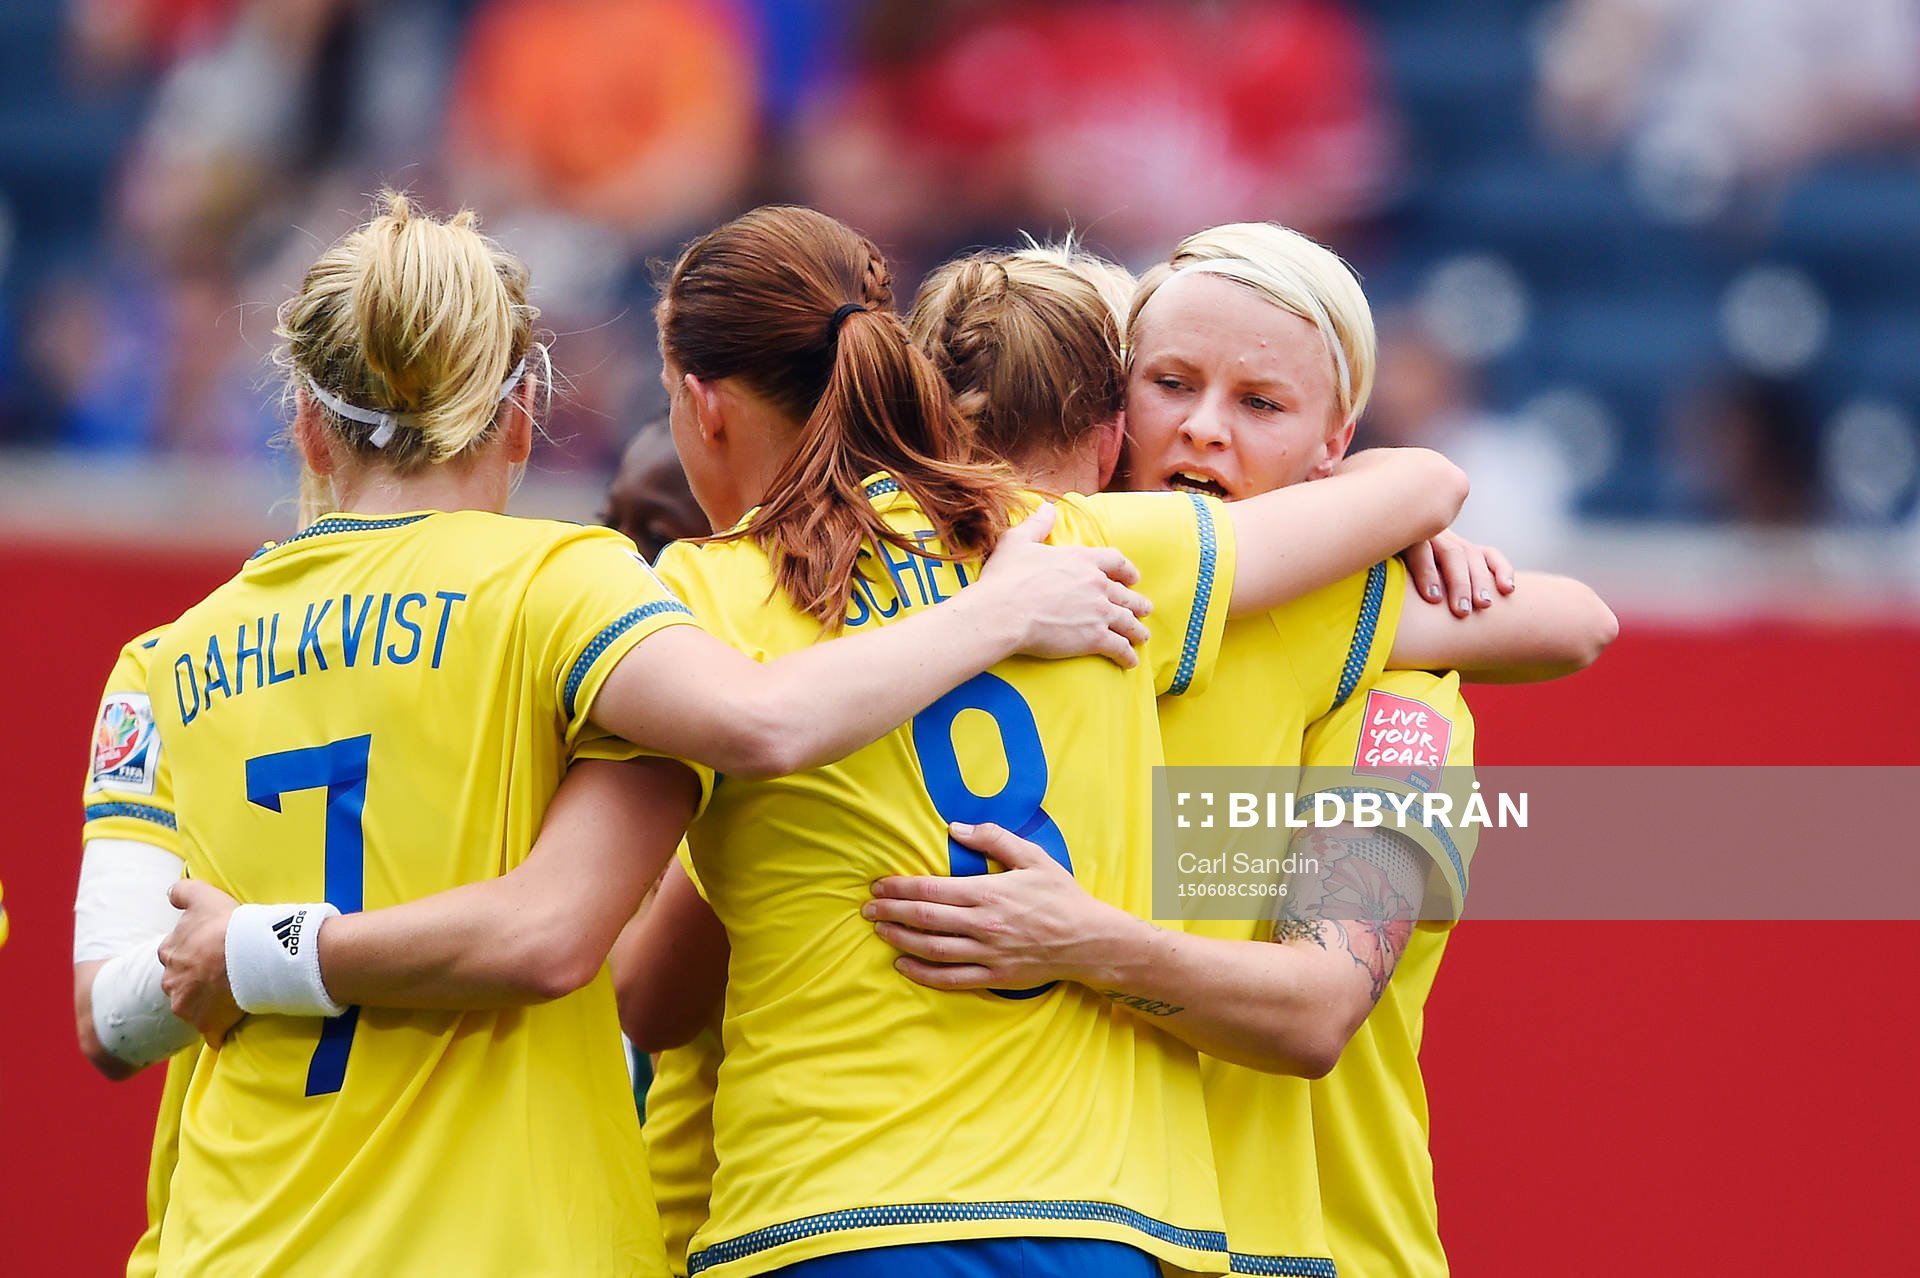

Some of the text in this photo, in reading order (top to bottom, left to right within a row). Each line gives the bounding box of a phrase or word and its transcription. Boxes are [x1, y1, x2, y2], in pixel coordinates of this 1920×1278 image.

[174, 590, 467, 727] DAHLKVIST
[1369, 728, 1438, 752] YOUR
[1373, 708, 1429, 729] LIVE
[1364, 747, 1439, 771] GOALS
[912, 670, 1075, 1000] 8
[245, 733, 371, 1097] 7
[289, 910, 307, 956] adidas
